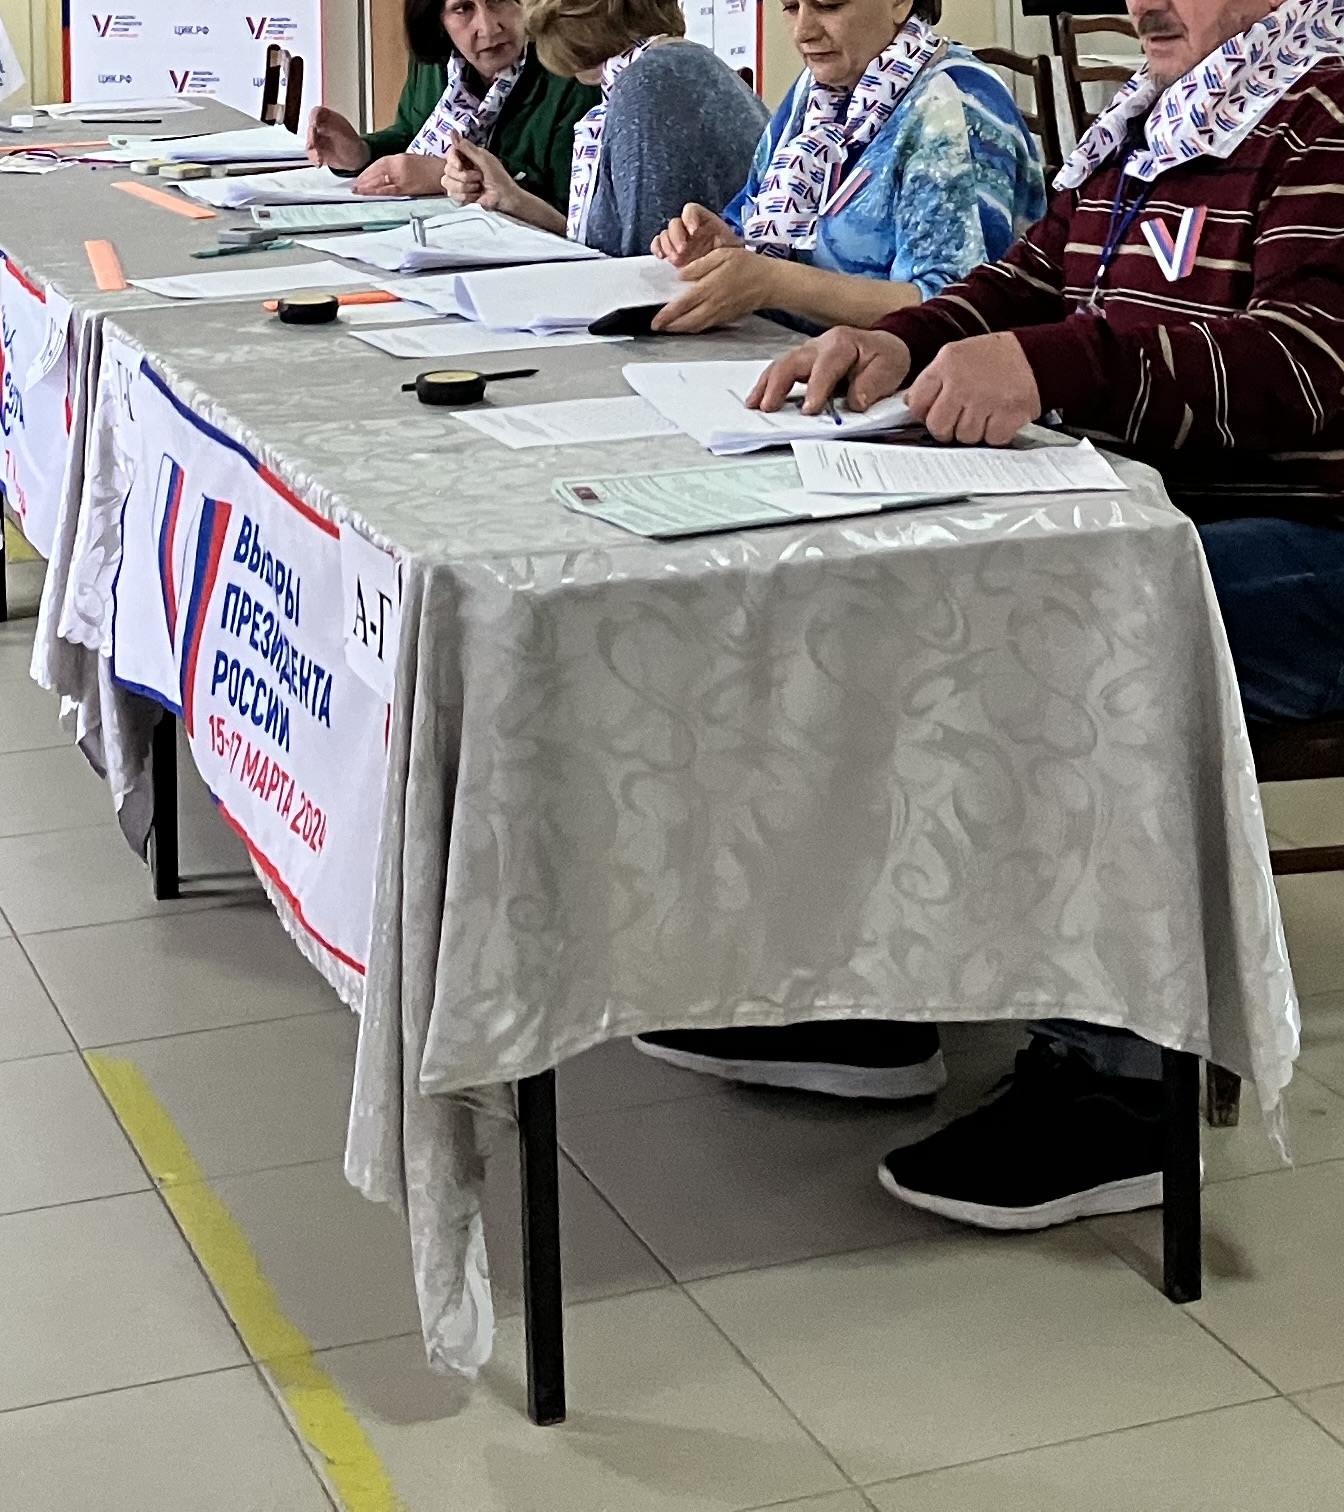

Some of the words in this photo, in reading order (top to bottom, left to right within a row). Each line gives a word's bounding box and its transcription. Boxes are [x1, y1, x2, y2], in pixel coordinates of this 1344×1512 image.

[220, 582, 333, 729] ПРЕЗИДЕНТА
[353, 573, 393, 662] А-Г
[211, 649, 291, 753] РОССИИ
[208, 714, 243, 773] 15-17
[240, 742, 296, 822] МАРТА
[289, 791, 329, 856] 2024
